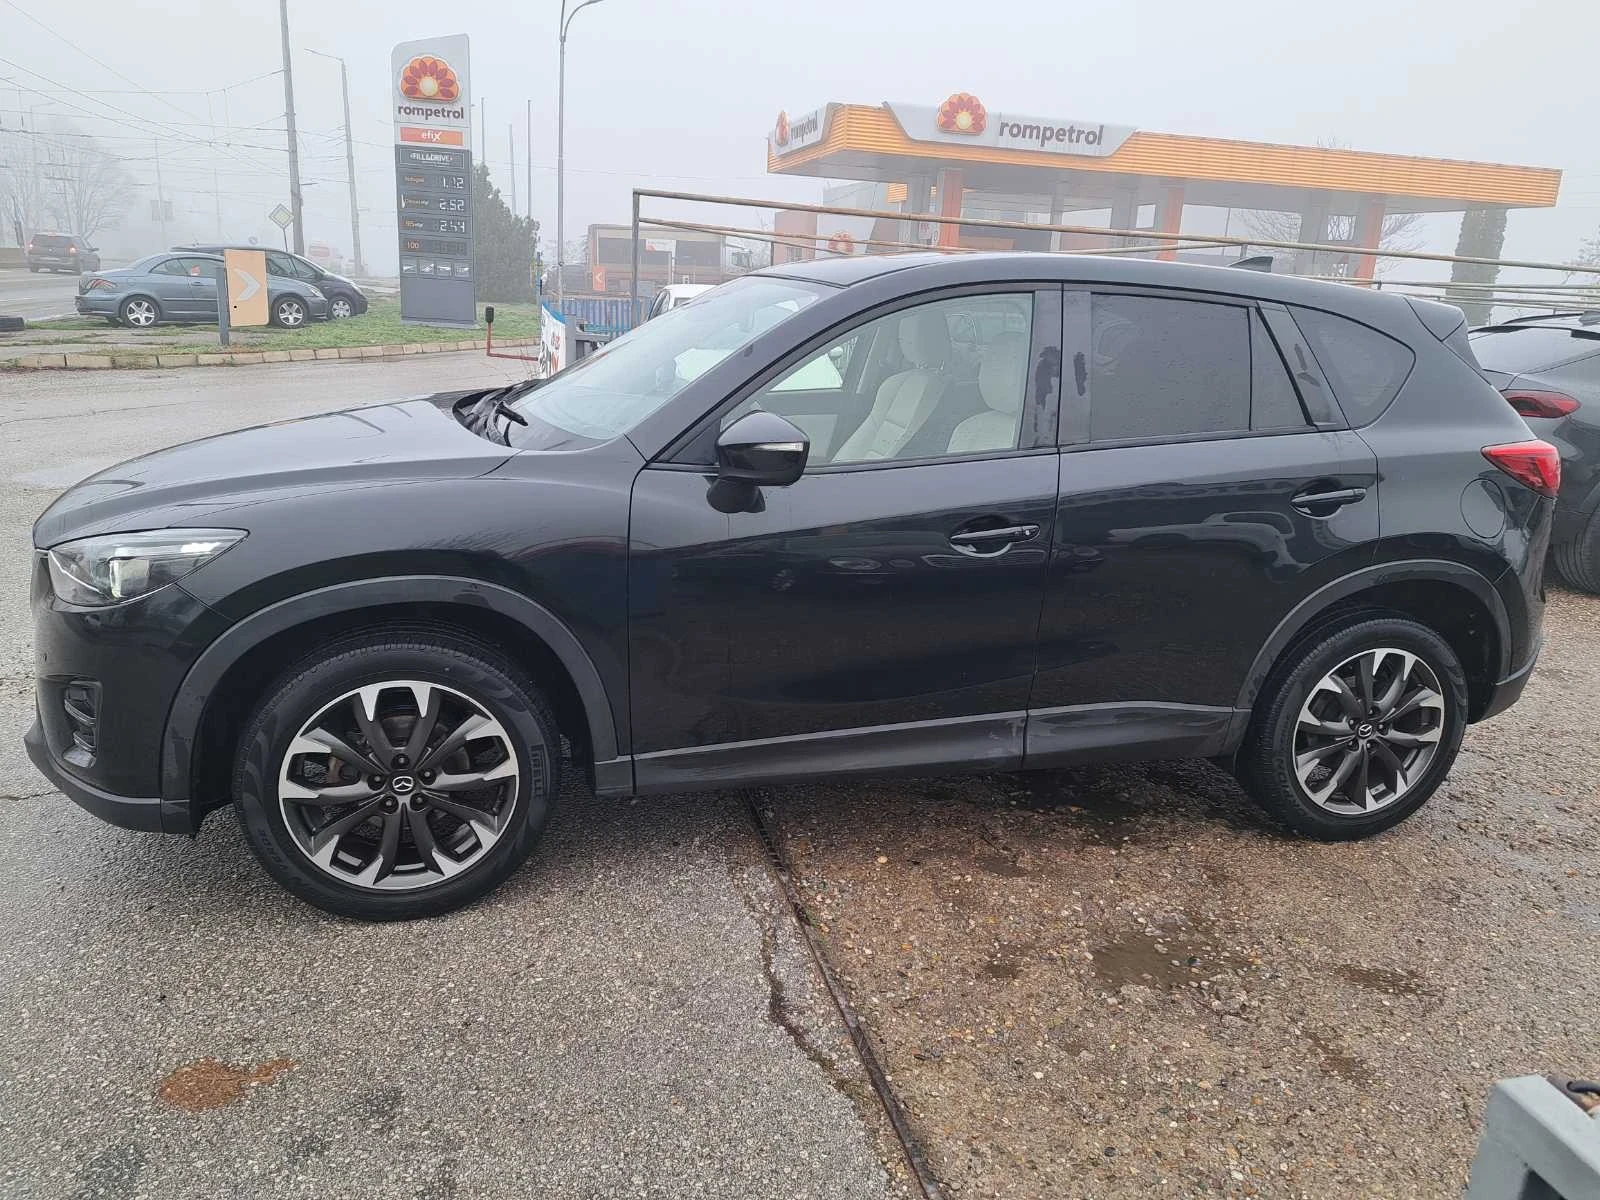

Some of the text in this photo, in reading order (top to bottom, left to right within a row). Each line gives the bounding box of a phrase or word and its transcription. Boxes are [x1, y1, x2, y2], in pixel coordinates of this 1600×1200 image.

[398, 105, 464, 120] rompetrol
[999, 120, 1104, 147] rompetrol
[439, 198, 465, 212] 2.52
[407, 241, 420, 250] 100
